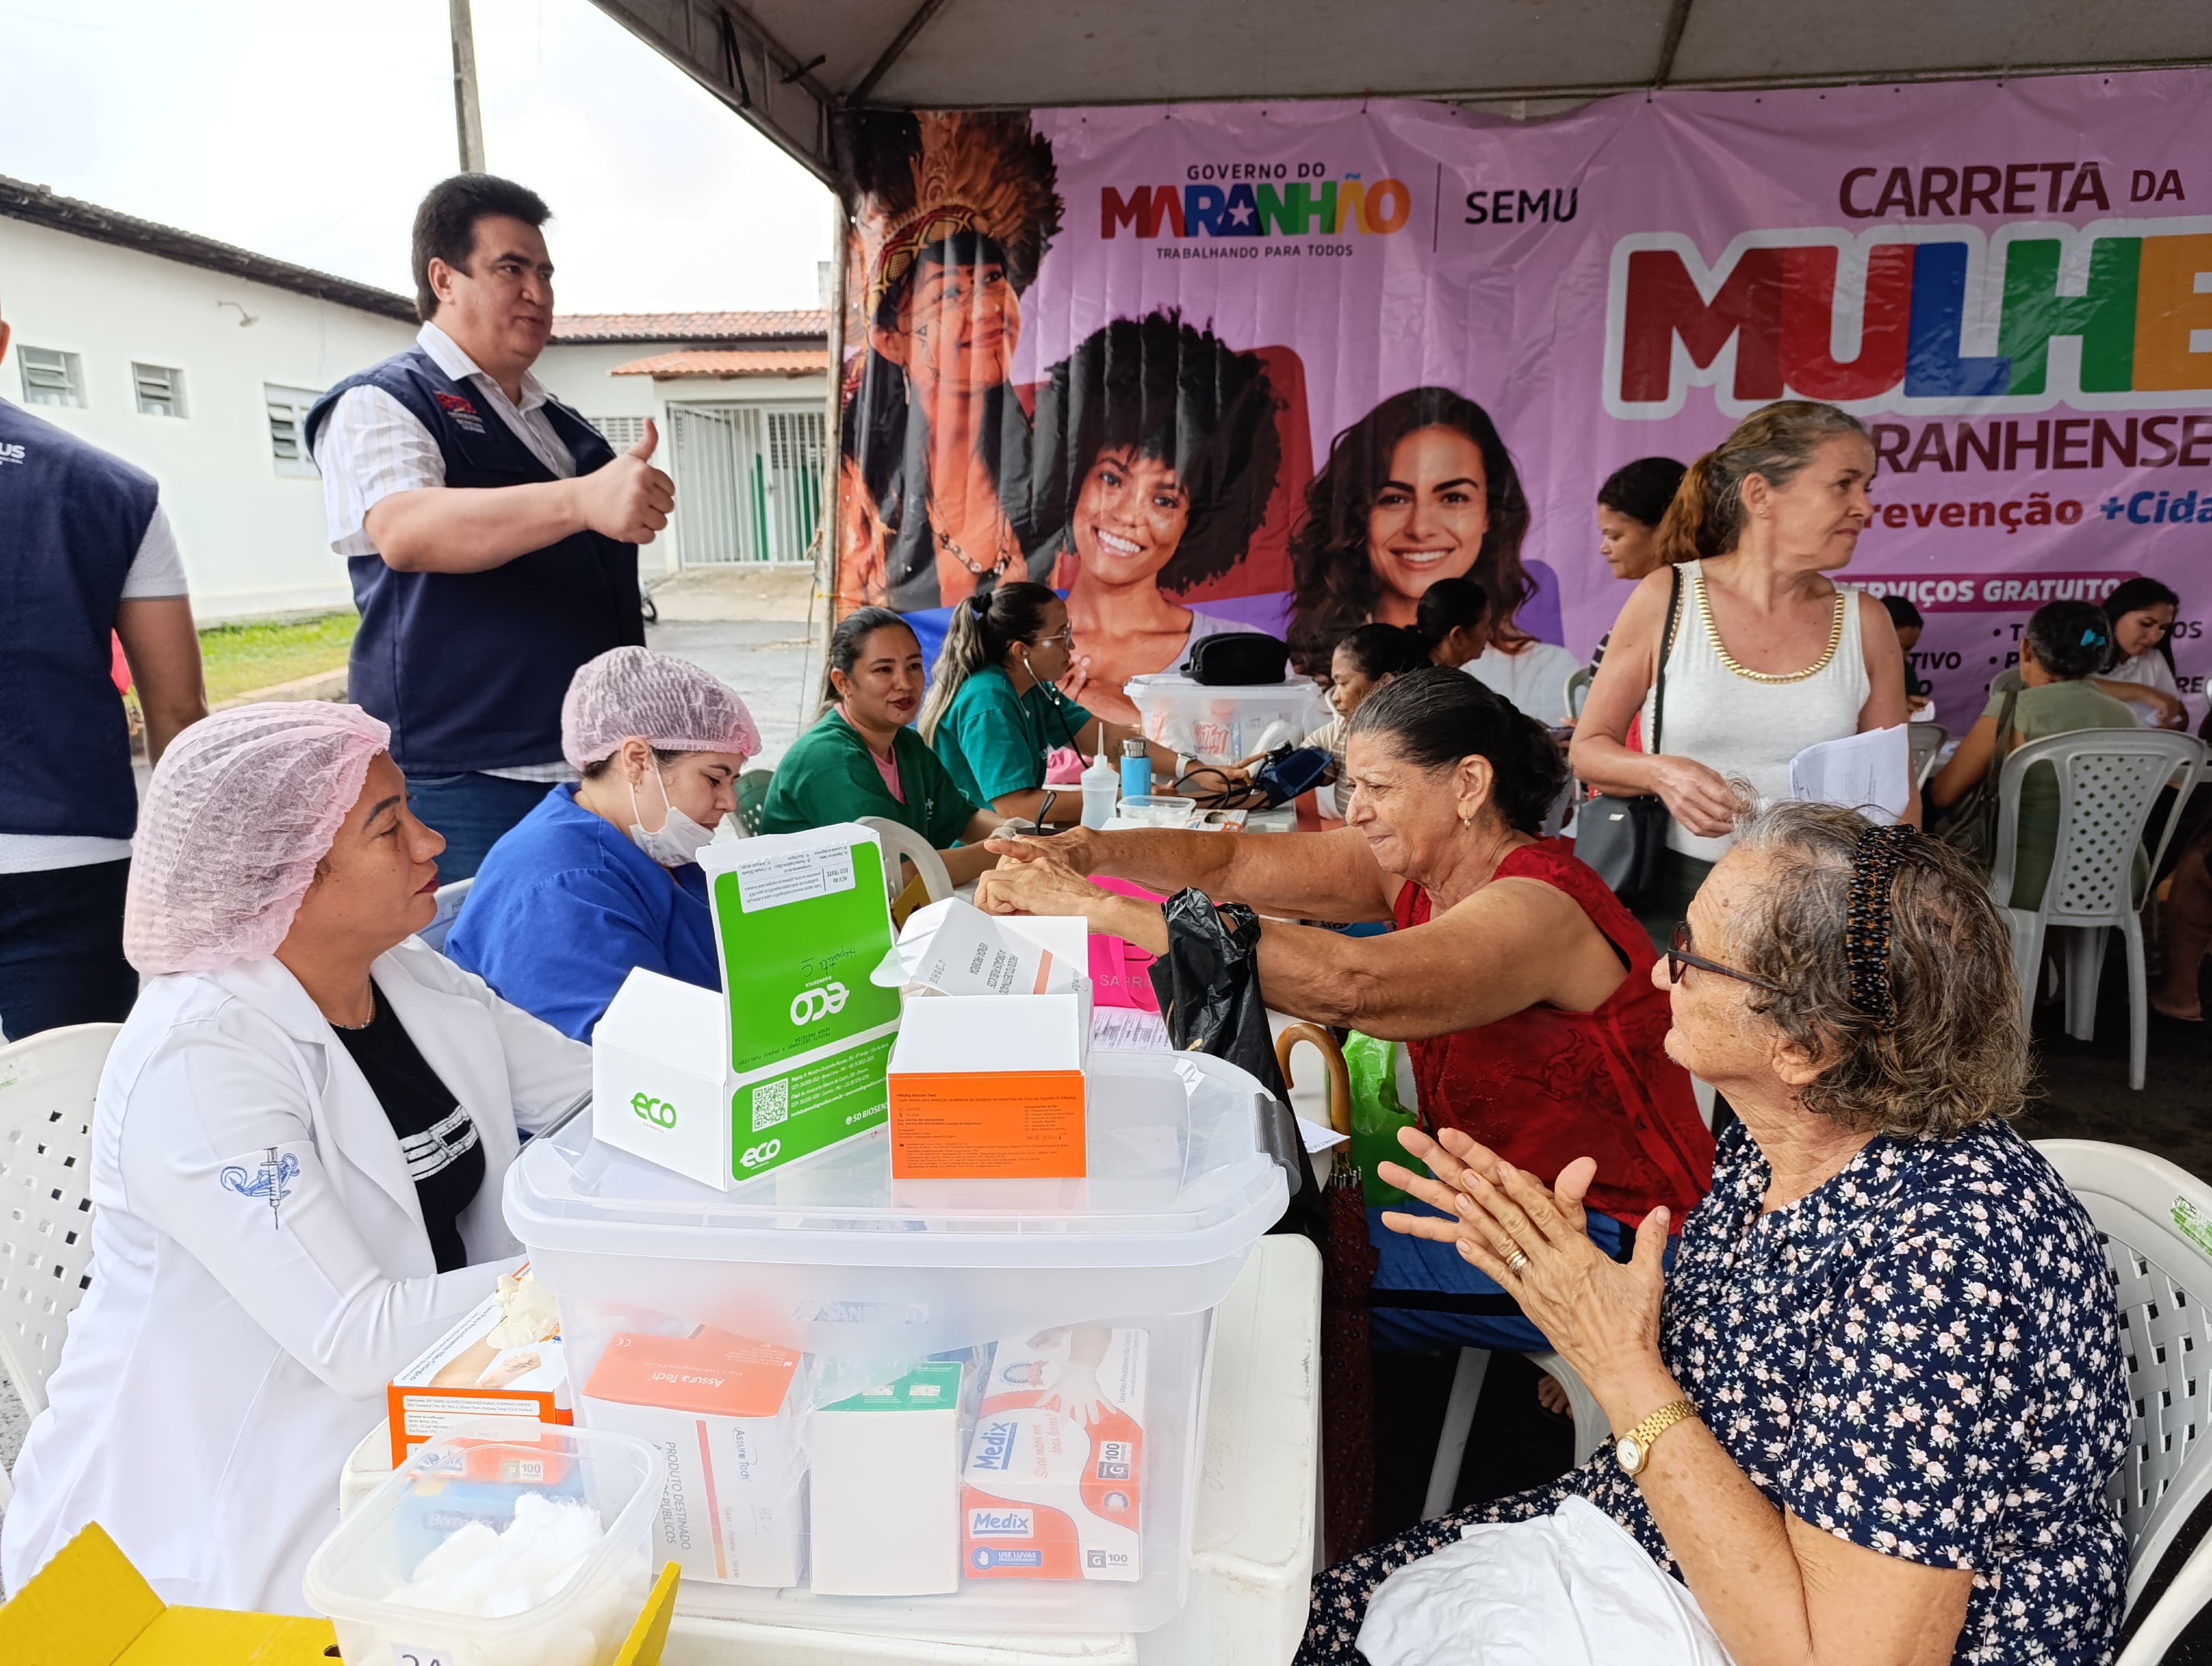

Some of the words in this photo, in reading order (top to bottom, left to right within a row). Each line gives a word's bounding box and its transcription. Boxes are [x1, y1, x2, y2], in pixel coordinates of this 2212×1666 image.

[1187, 163, 1287, 180] GOVERNO
[1298, 162, 1326, 178] DO
[1838, 161, 2110, 218] CARRETA
[2130, 169, 2185, 202] DA
[1101, 172, 1411, 239] MARANHÃO
[1465, 188, 1578, 225] SEMU
[1156, 247, 1259, 260] TRABALHANDO
[1264, 245, 1301, 258] PARA
[1307, 244, 1353, 257] TODOS
[1846, 579, 1975, 608] RVIÇOS
[1983, 577, 2129, 603] GRATUITO
[805, 975, 832, 987] DIAGNÓSTICA
[790, 982, 850, 1026] eco
[812, 1031, 831, 1041] PRODUTO
[816, 1027, 830, 1035] VENDA
[786, 1038, 811, 1049] DESTINADO
[630, 1092, 677, 1129] eco
[852, 1113, 863, 1123] SD
[740, 1138, 780, 1167] eco
[973, 1422, 1009, 1470] Medix
[1105, 1443, 1120, 1461] 100
[521, 1463, 541, 1473] 100
[665, 1441, 682, 1492] PRODUTO
[661, 1497, 676, 1545] PÚBLICOS
[673, 1492, 691, 1550] DESTINADO
[973, 1513, 1029, 1529] Medix
[1108, 1554, 1128, 1563] 100
